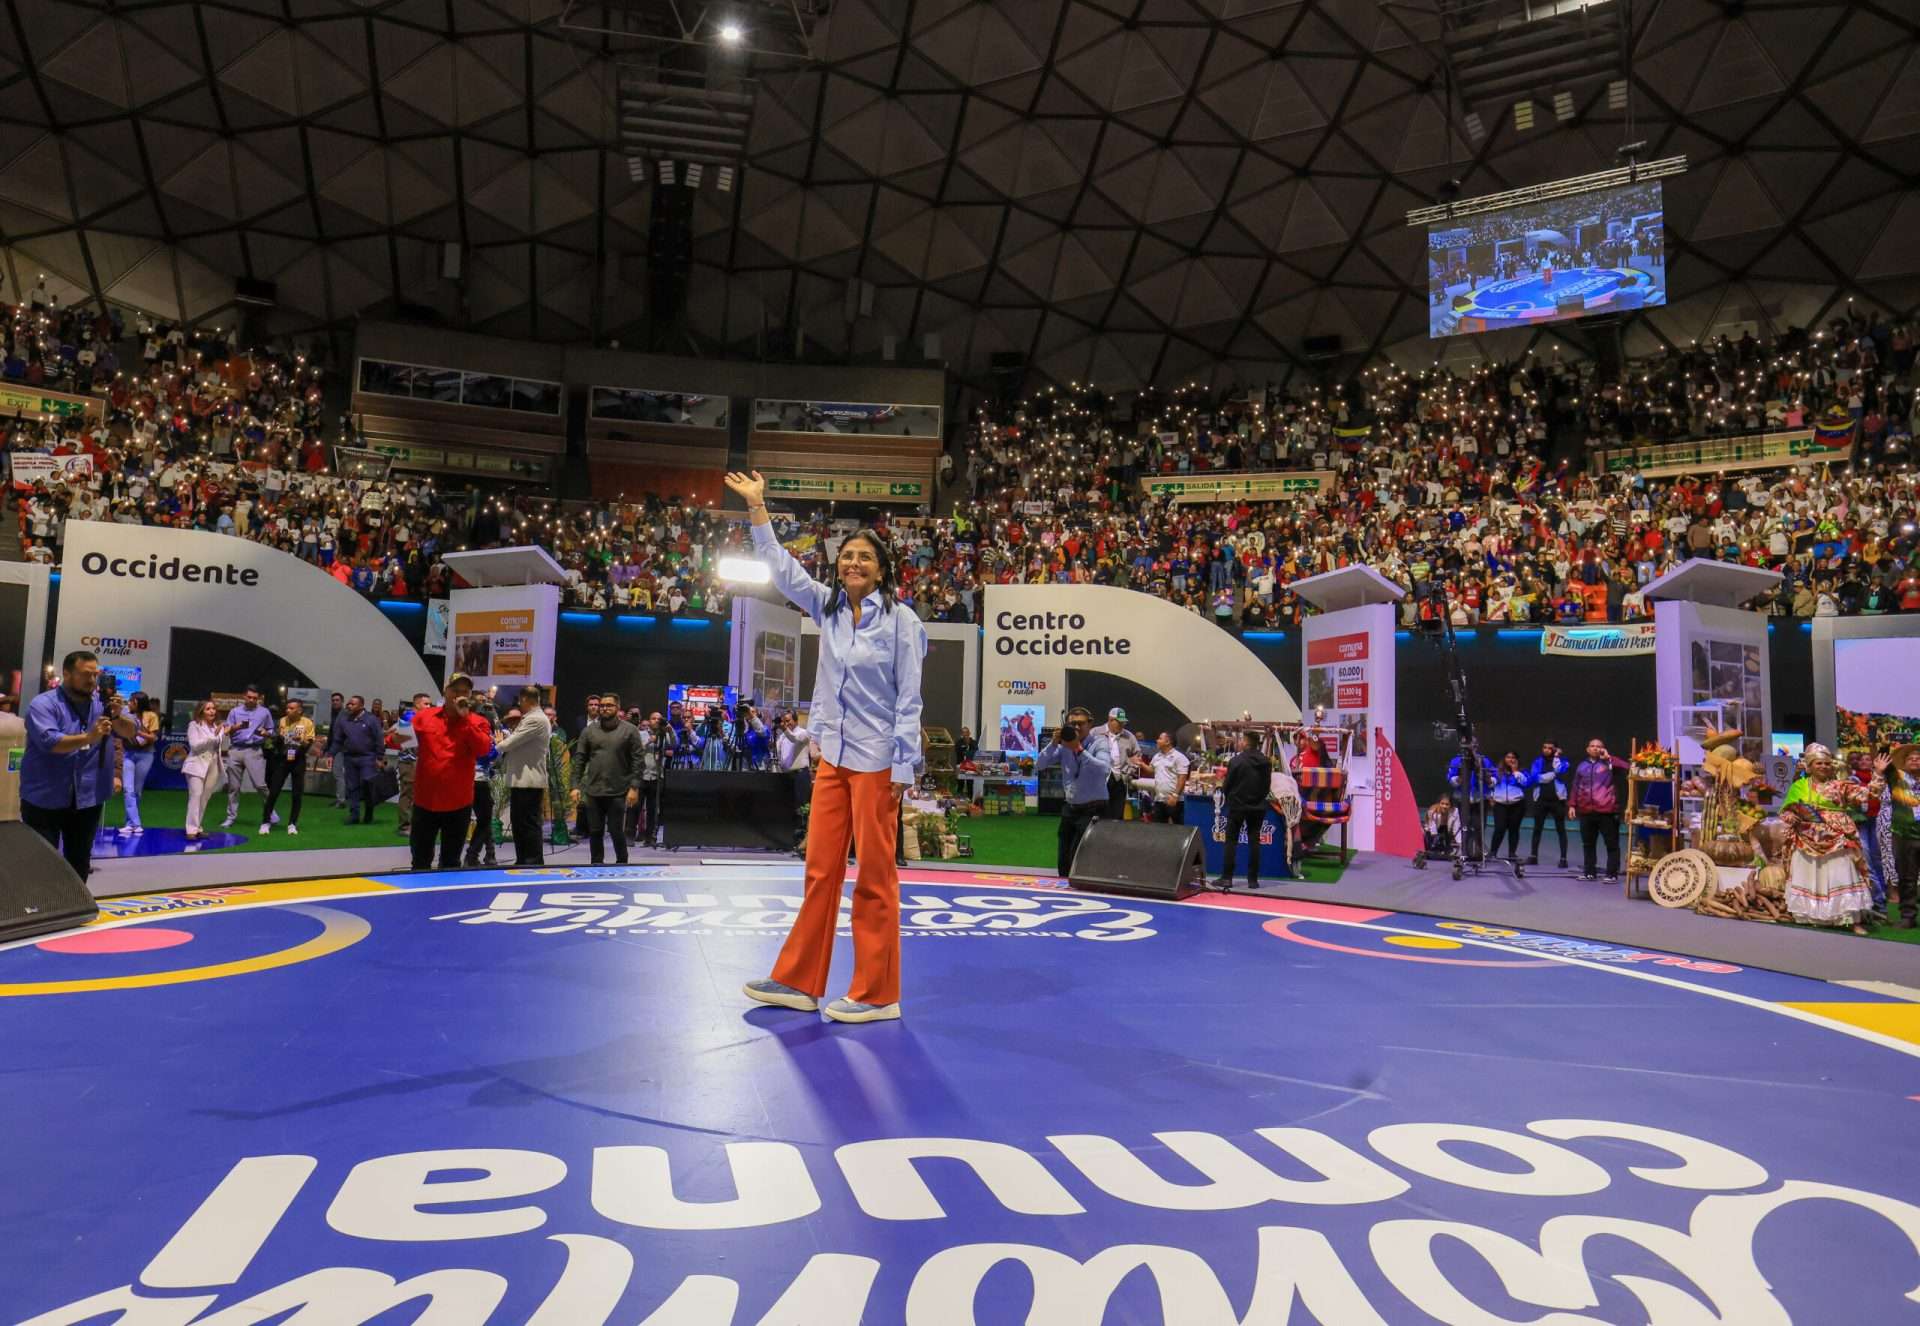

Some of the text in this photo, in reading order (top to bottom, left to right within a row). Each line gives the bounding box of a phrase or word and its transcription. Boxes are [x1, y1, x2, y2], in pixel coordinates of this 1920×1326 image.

[866, 487, 883, 495] EXIT
[1186, 482, 1215, 490] SALIDA
[82, 552, 259, 587] Occidente
[996, 611, 1085, 630] Centro
[81, 635, 149, 650] comuna
[995, 633, 1131, 655] Occidente
[997, 680, 1046, 690] comuna
[1384, 747, 1392, 801] Centro
[1375, 746, 1384, 826] Occidente
[139, 1118, 1769, 1288] comunal
